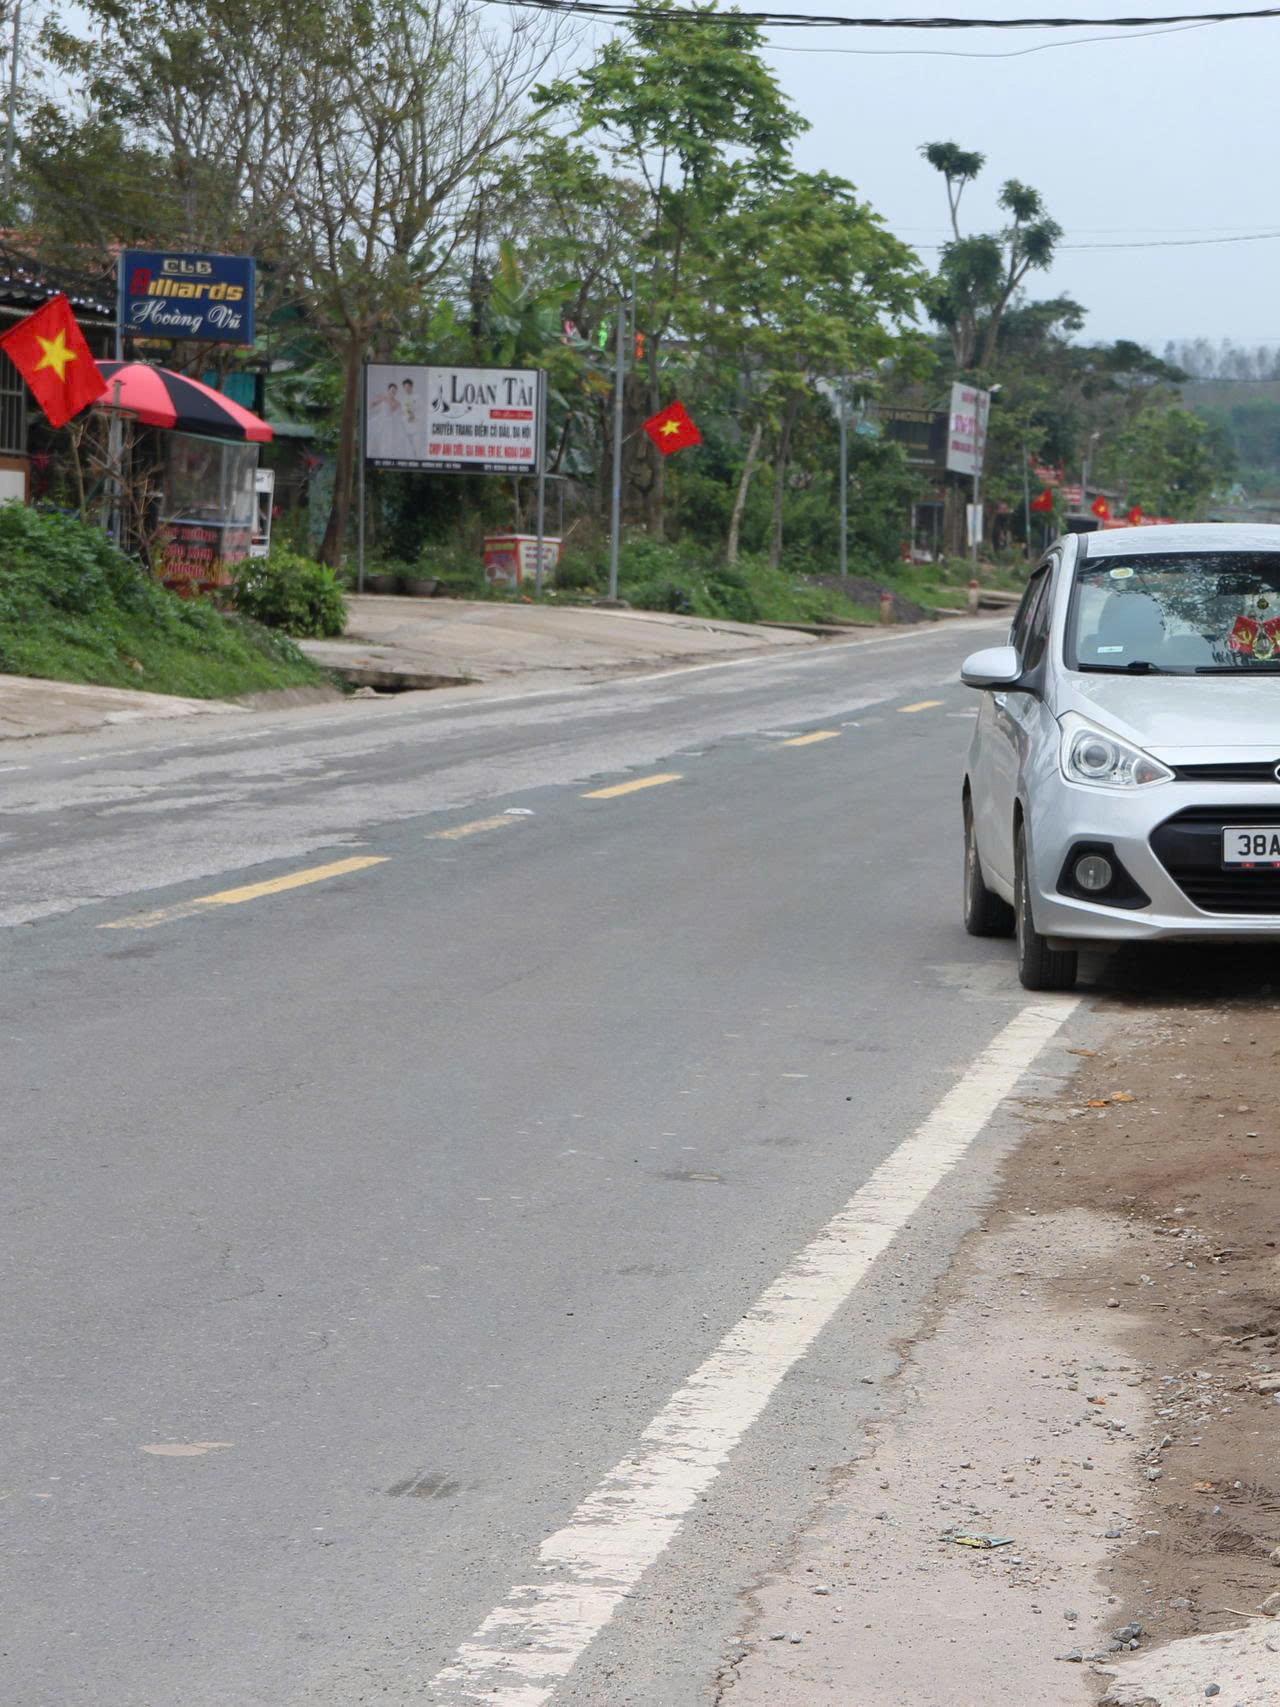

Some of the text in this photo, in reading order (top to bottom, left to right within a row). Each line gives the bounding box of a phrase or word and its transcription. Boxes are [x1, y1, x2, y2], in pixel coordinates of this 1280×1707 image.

[130, 267, 244, 301] Billiards
[162, 259, 212, 275] CLB
[131, 299, 243, 334] Hoàng Vũ
